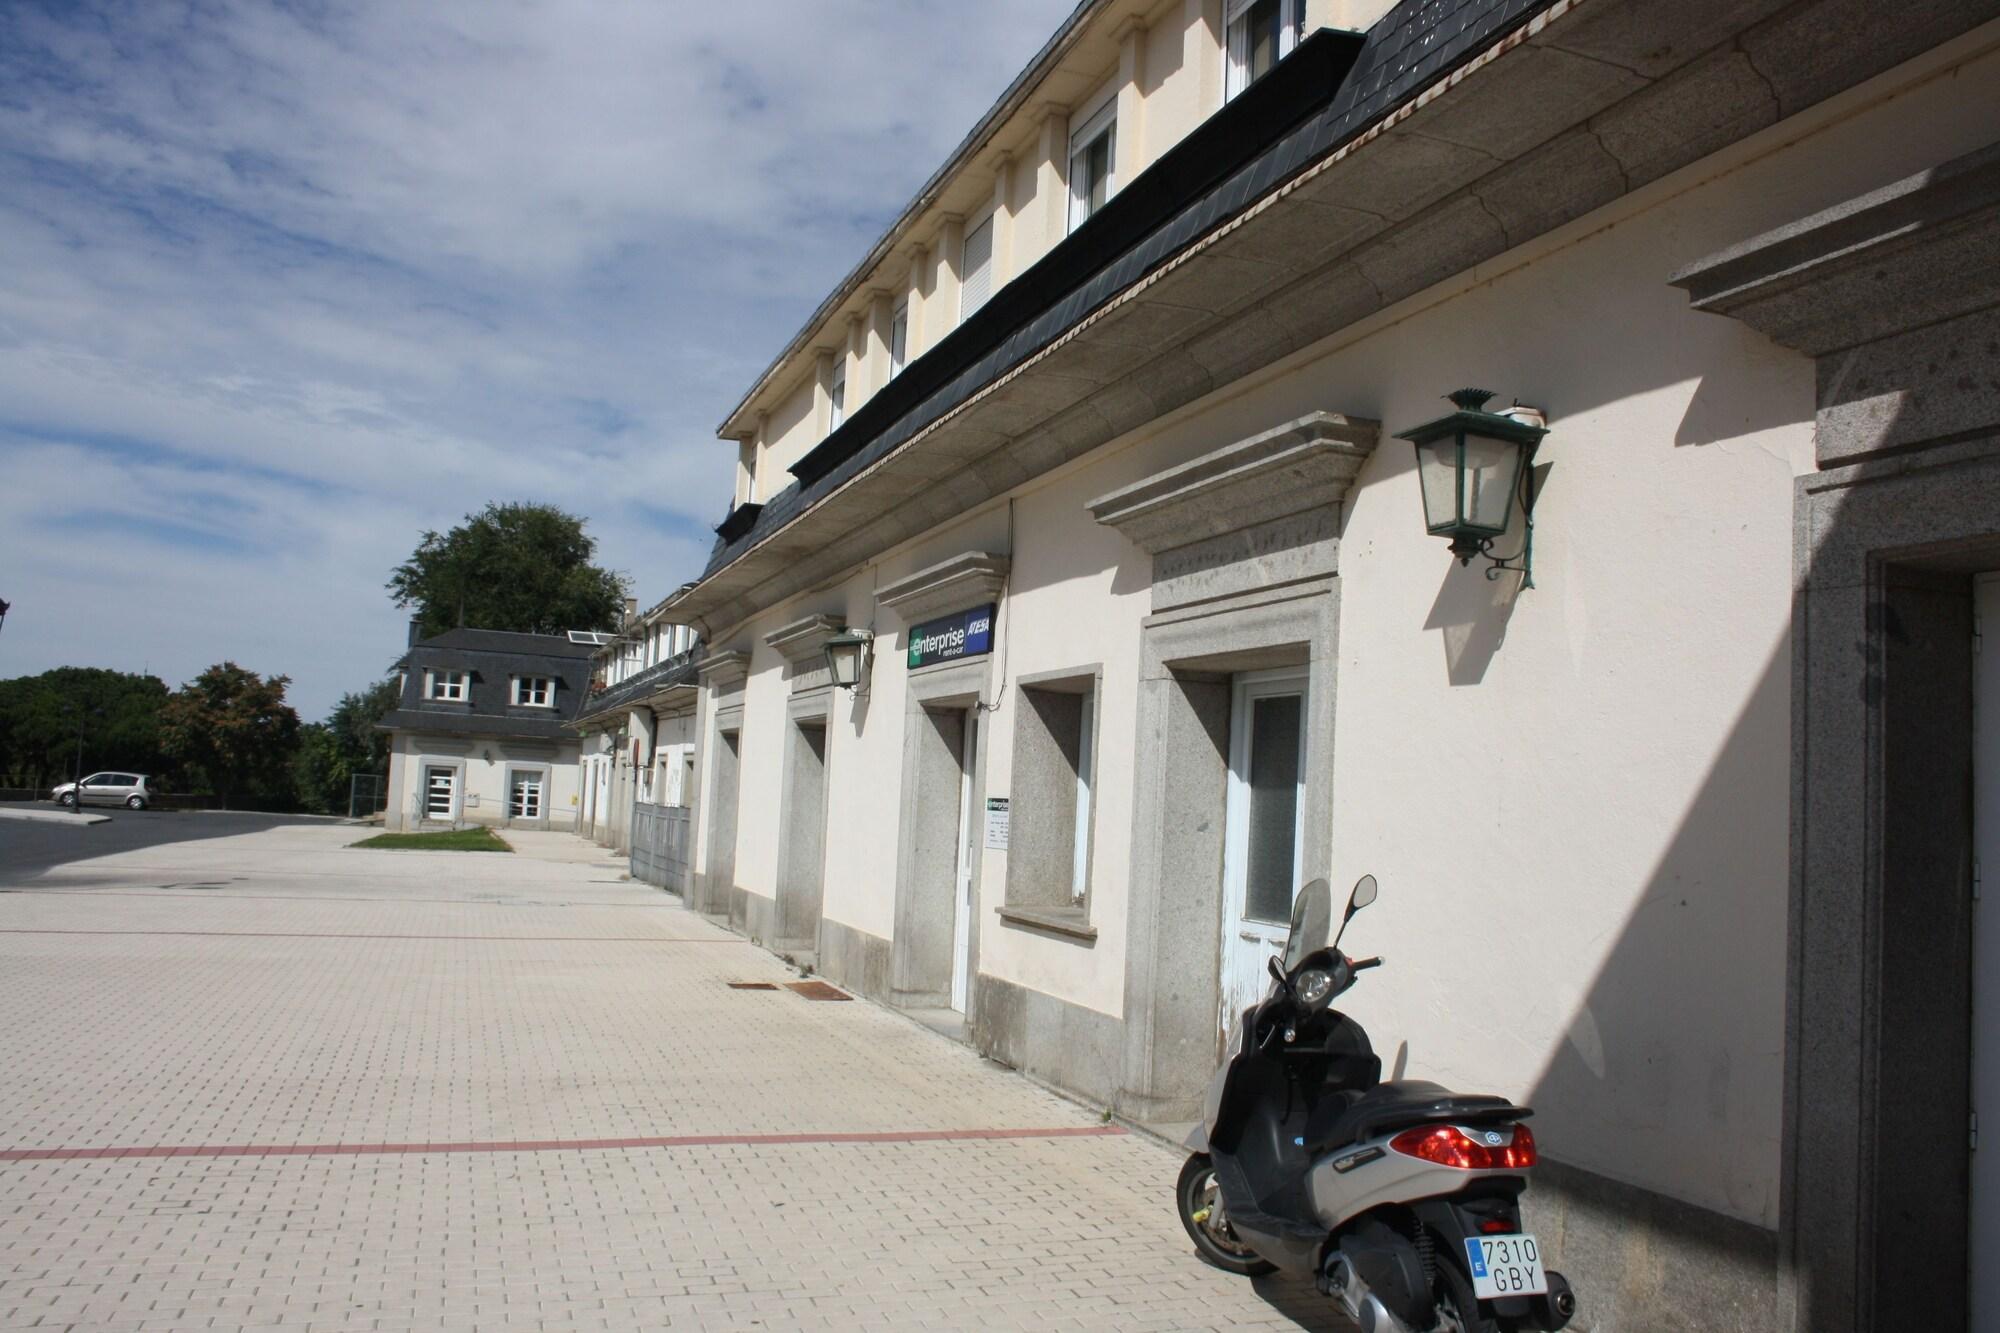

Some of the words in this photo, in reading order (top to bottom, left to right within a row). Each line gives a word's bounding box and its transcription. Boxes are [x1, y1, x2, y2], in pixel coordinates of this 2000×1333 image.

[967, 617, 989, 636] ATESA
[911, 627, 964, 655] enterprise
[1483, 1239, 1537, 1265] 7310
[1475, 1262, 1484, 1272] E
[1494, 1266, 1536, 1292] GBY
